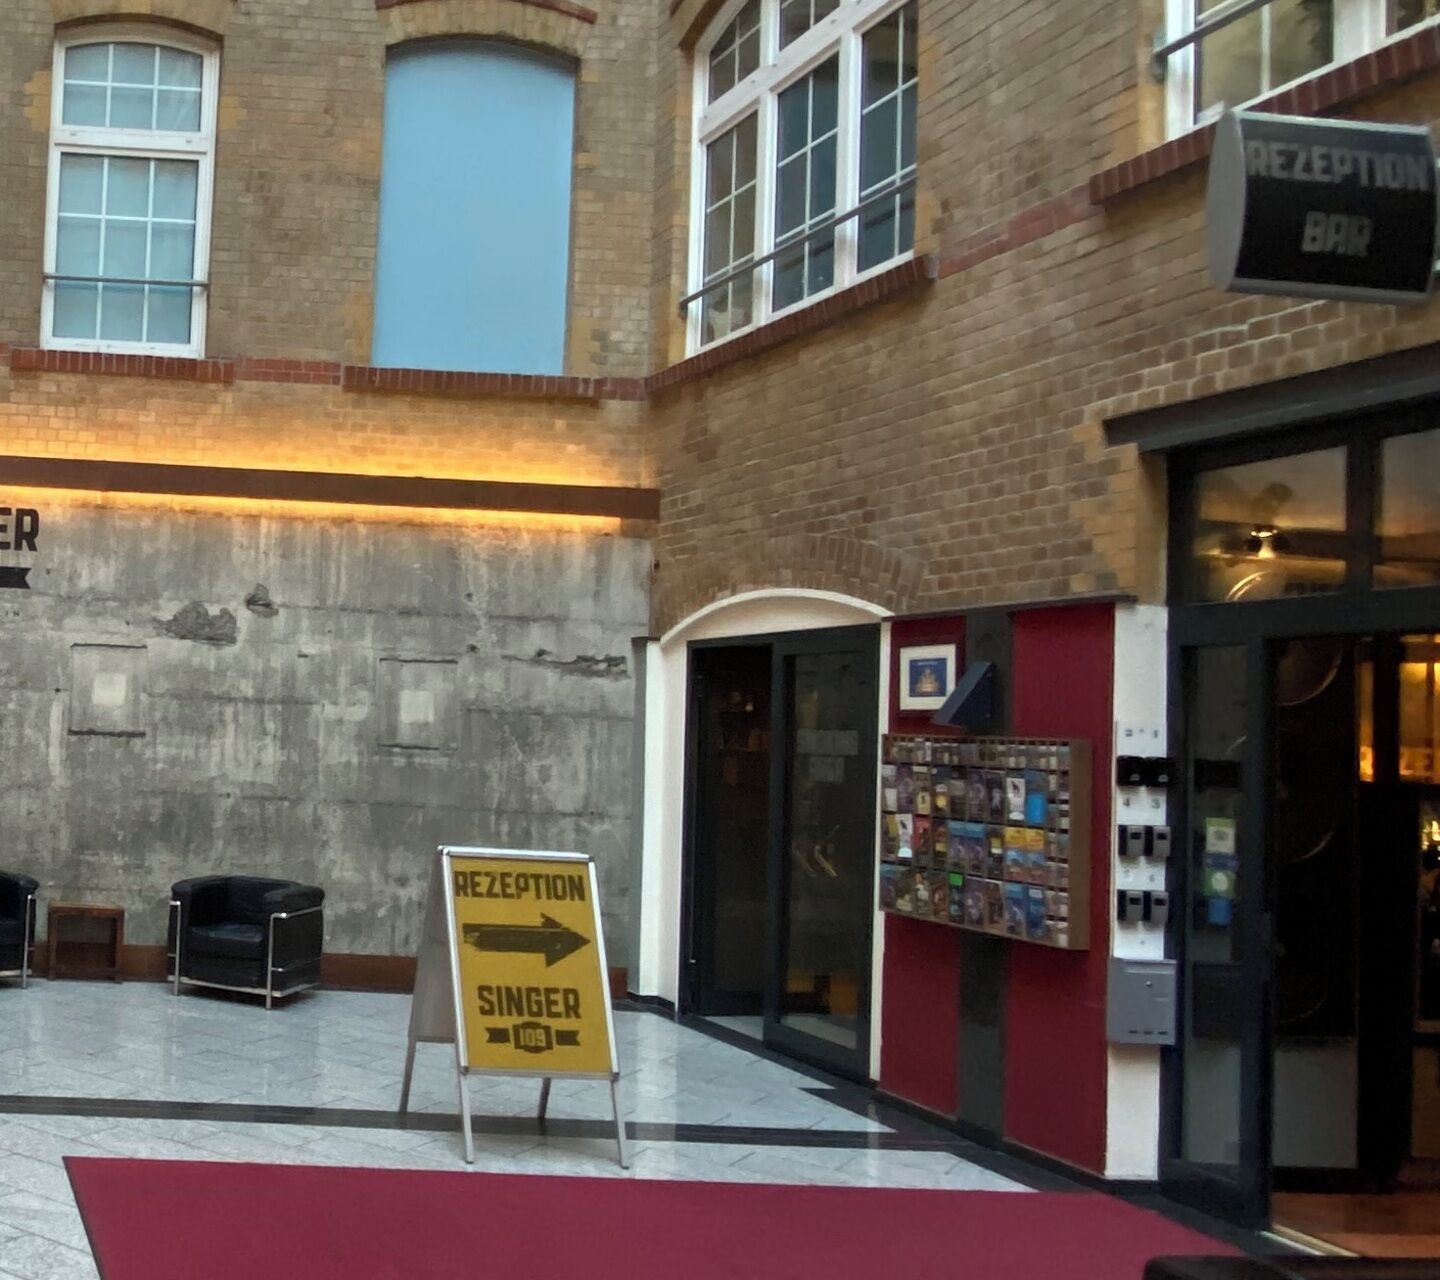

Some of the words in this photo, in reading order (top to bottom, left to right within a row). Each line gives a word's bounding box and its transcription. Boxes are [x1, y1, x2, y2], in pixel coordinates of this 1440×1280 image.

[1245, 139, 1430, 191] REZEPTION
[1301, 210, 1373, 257] BAR
[454, 871, 586, 901] REZEPTION
[477, 985, 582, 1019] SINGER
[519, 1028, 545, 1048] 109
